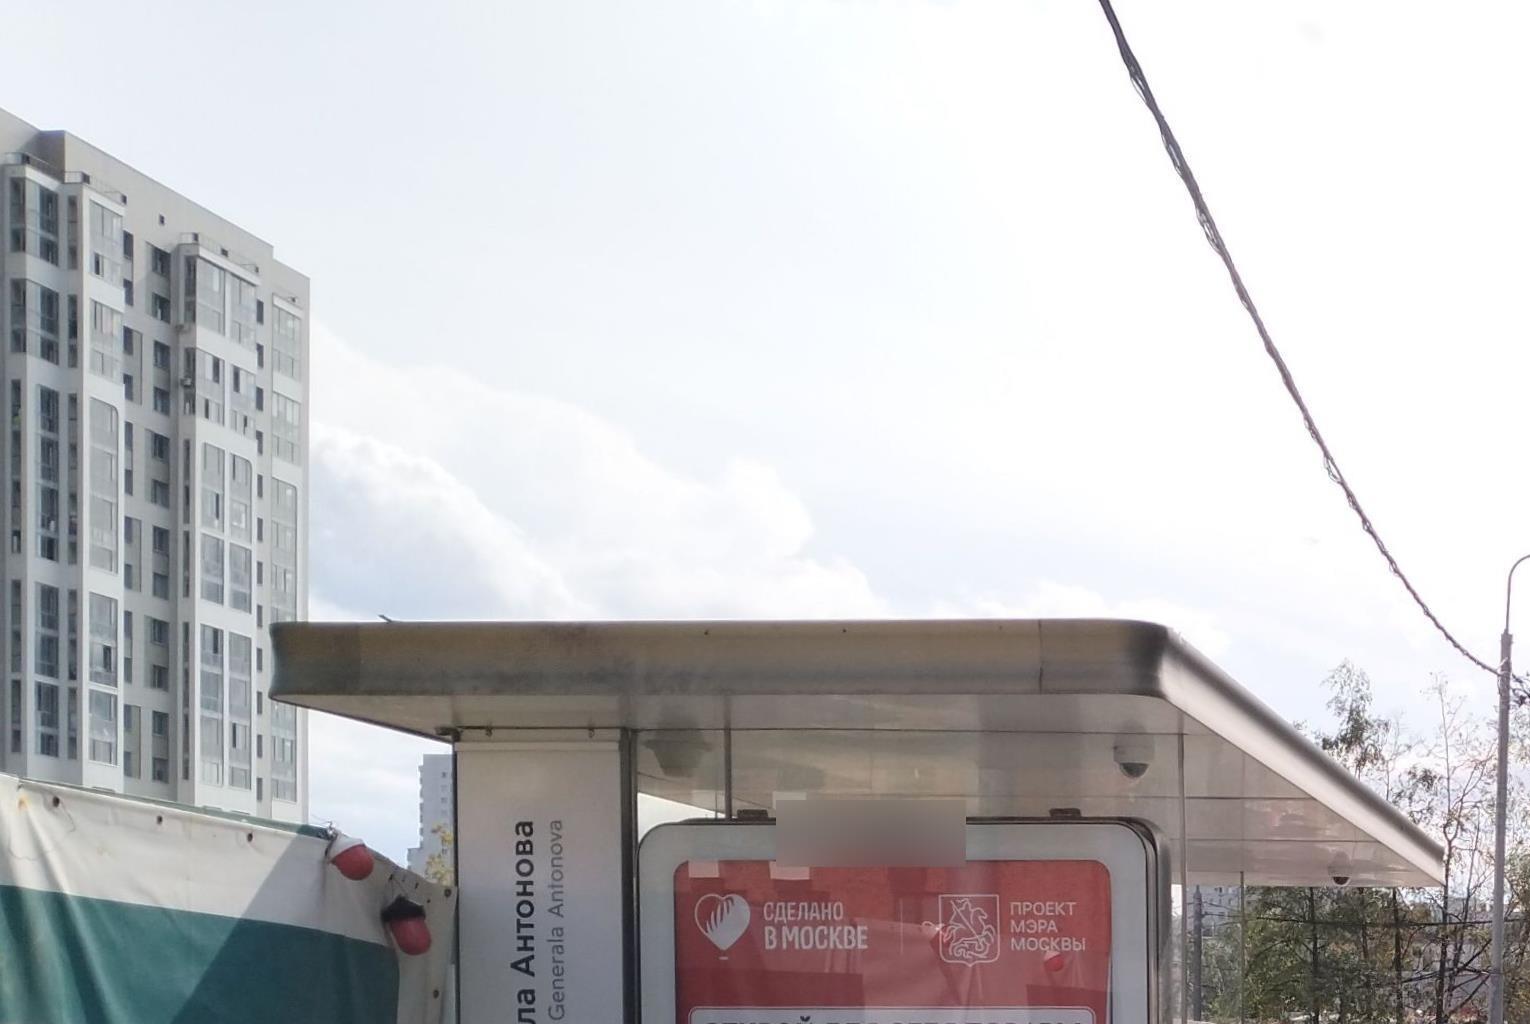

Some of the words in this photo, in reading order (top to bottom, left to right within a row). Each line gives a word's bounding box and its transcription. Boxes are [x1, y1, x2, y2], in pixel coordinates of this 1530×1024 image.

[549, 819, 563, 918] Antonova
[511, 820, 535, 977] Антонова
[1010, 902, 1076, 917] ПРОЕКТ
[764, 901, 844, 922] СДЕЛАНО
[1010, 918, 1058, 933] МЭРА
[765, 926, 781, 950] В
[783, 925, 869, 950] МОСКВЕ
[1010, 936, 1086, 952] МОСКВЫ
[548, 925, 566, 1021] Generala
